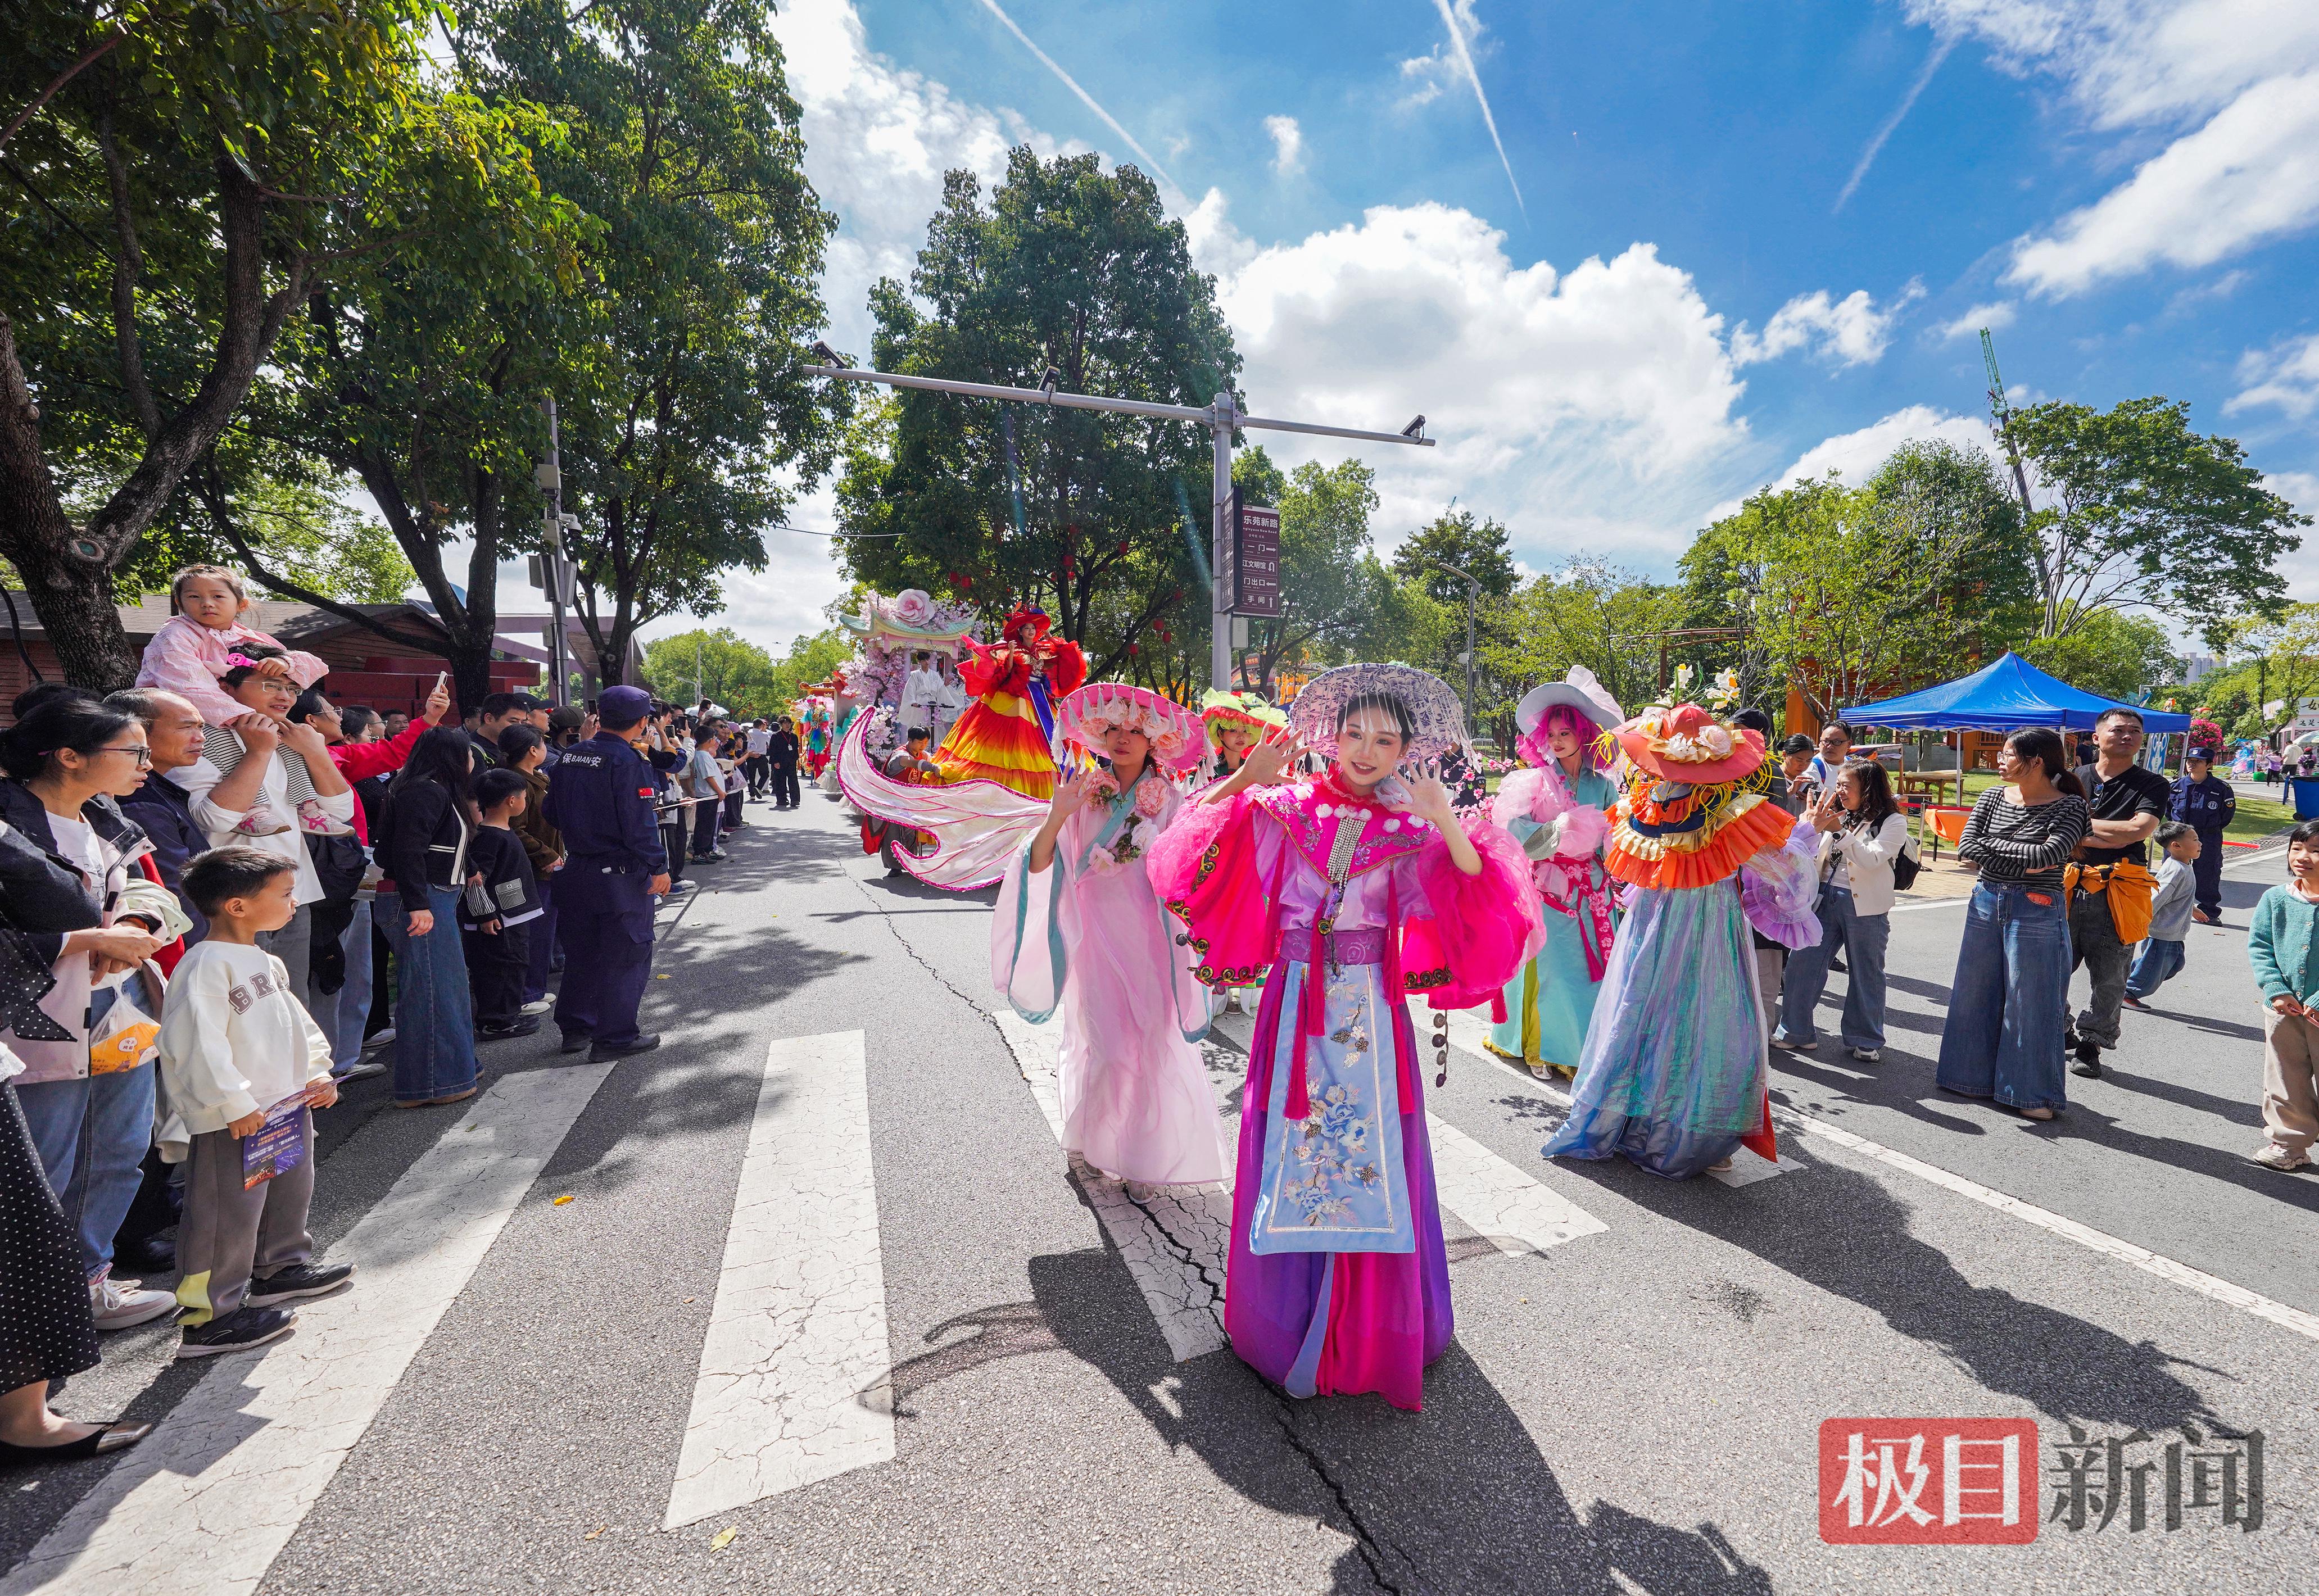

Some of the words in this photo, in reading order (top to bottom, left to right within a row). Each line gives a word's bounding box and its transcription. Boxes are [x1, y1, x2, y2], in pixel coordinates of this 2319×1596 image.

[1244, 515, 1278, 528] 乐苑新路
[1242, 542, 1265, 551] 一门
[1242, 560, 1266, 569] 江文明馆
[1244, 577, 1265, 586] 门出口
[1242, 595, 1265, 604] 手间
[2301, 699, 2319, 710] 女
